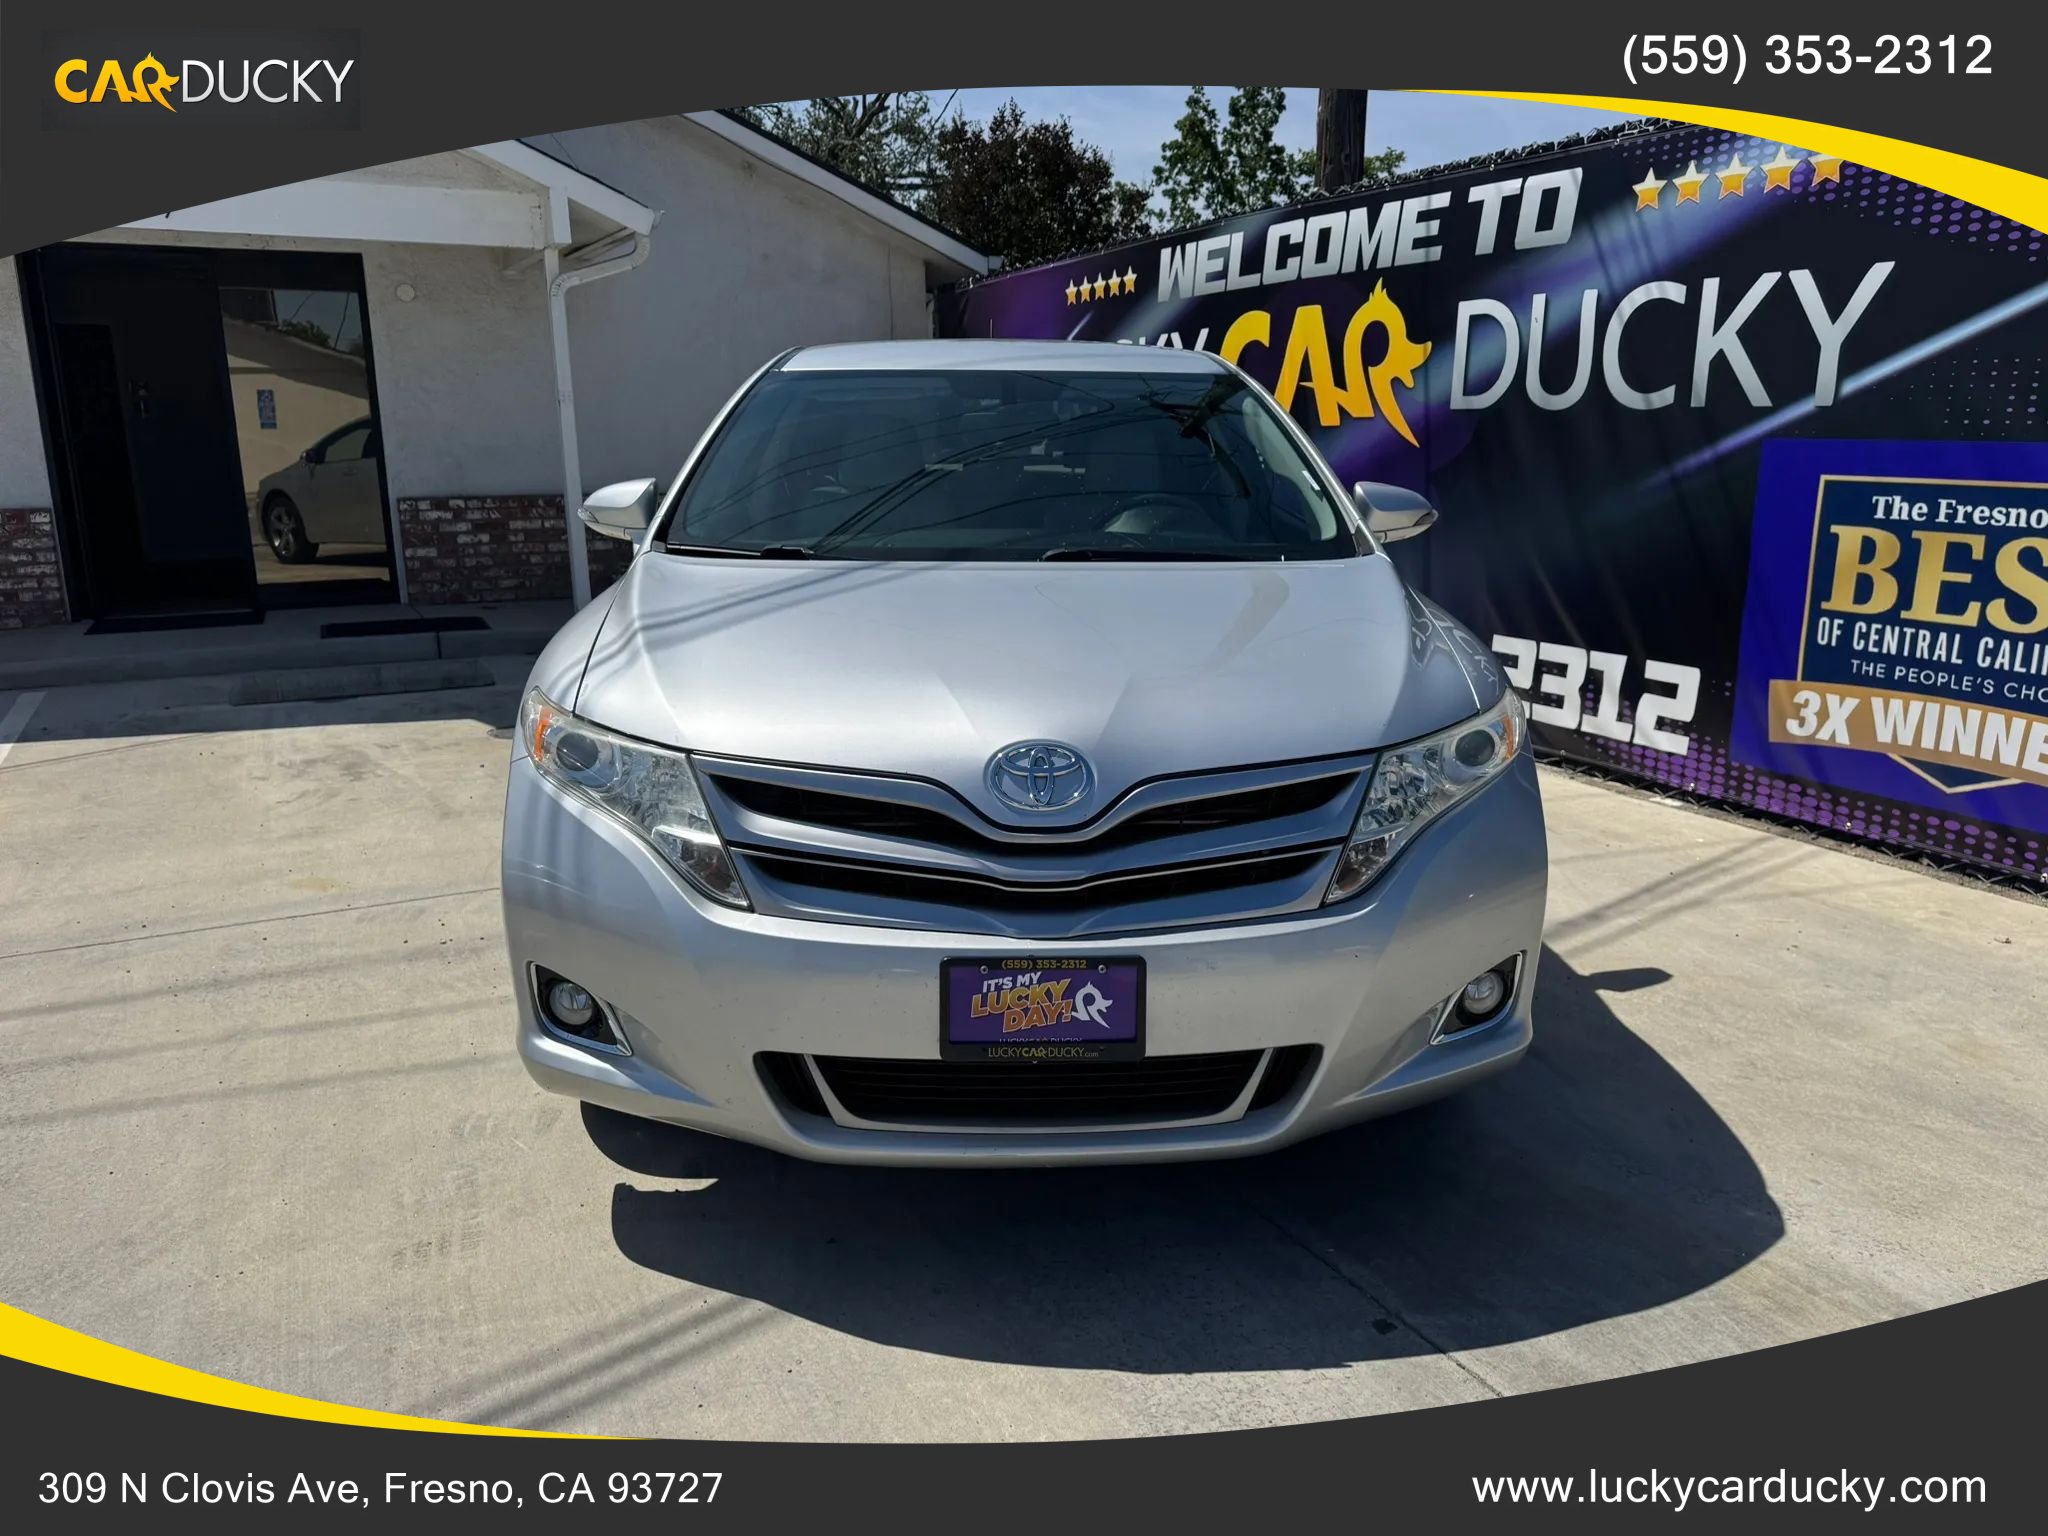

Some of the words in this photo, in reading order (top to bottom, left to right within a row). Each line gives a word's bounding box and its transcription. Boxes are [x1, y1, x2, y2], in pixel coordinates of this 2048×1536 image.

[1158, 191, 1451, 302] WELCOME
[1468, 167, 1583, 257] TO
[1450, 261, 1895, 411] DUCKY
[1872, 495, 1928, 522] The
[1935, 498, 2048, 529] Fresno
[1817, 617, 1844, 647] OF
[1852, 621, 1963, 665] CENTRAL
[1850, 659, 1886, 679] THE
[1894, 666, 1995, 695] PEOPLE'S
[1786, 690, 1861, 745] 3X
[982, 976, 1013, 993] IT'S
[1016, 971, 1042, 987] MY
[1001, 960, 1033, 970] (559)
[1036, 959, 1087, 969] 353-2312
[971, 978, 1071, 1018] LUCKY
[1003, 999, 1073, 1033] DAY!
